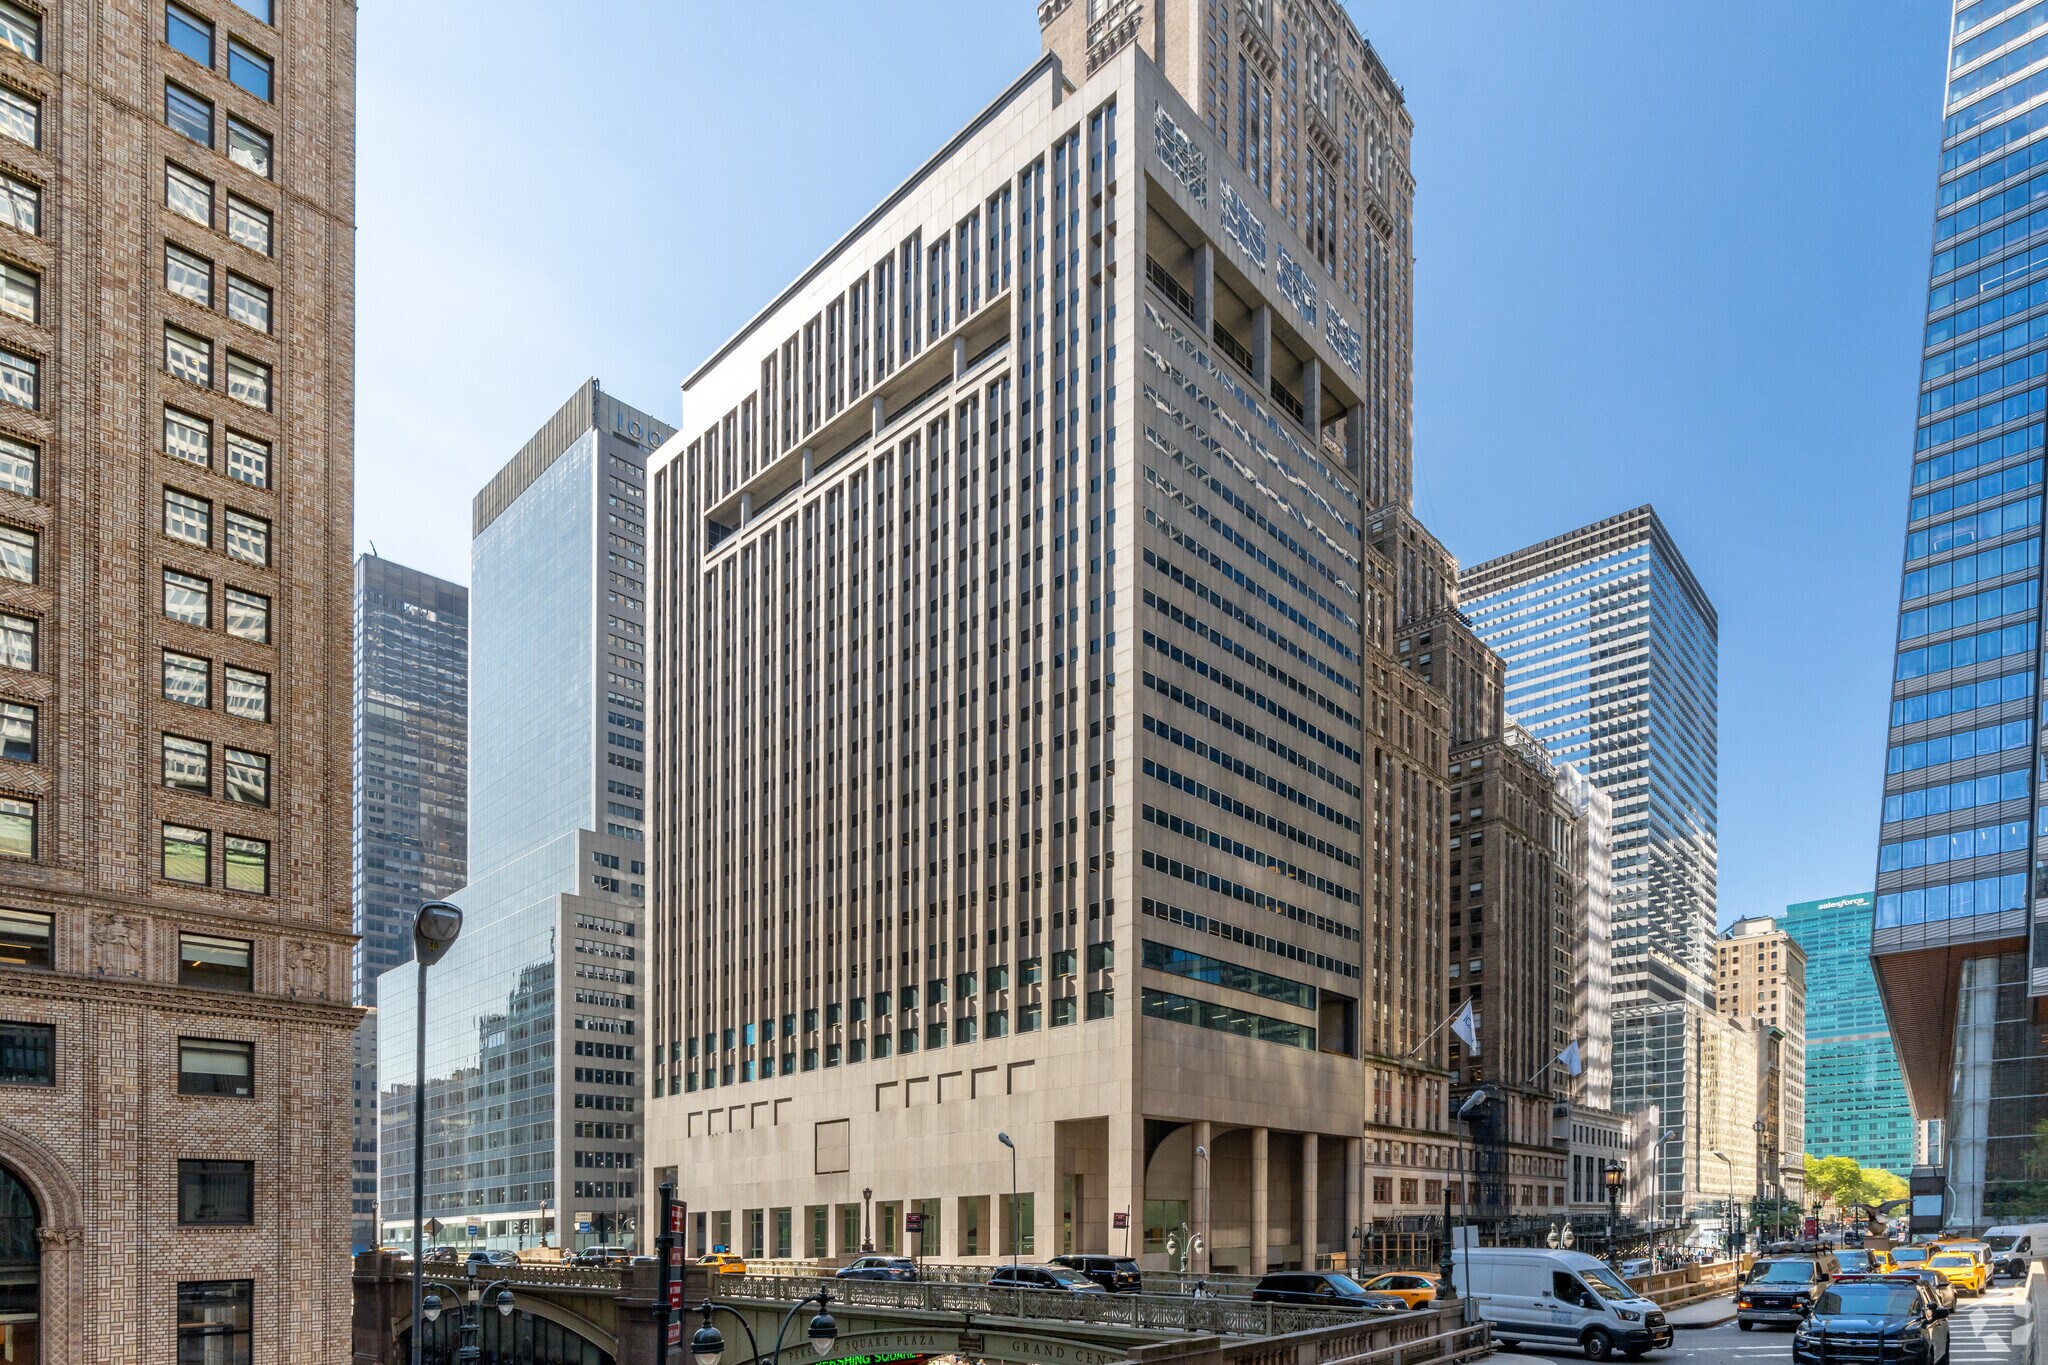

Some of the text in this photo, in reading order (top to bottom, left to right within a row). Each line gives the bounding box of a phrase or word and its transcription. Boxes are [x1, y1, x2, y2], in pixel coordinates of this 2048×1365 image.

[617, 411, 664, 449] 100
[1817, 897, 1865, 910] salesforce
[788, 1335, 935, 1361] PERSHG SQUARE PLAZA
[1012, 1340, 1065, 1358] GRAND
